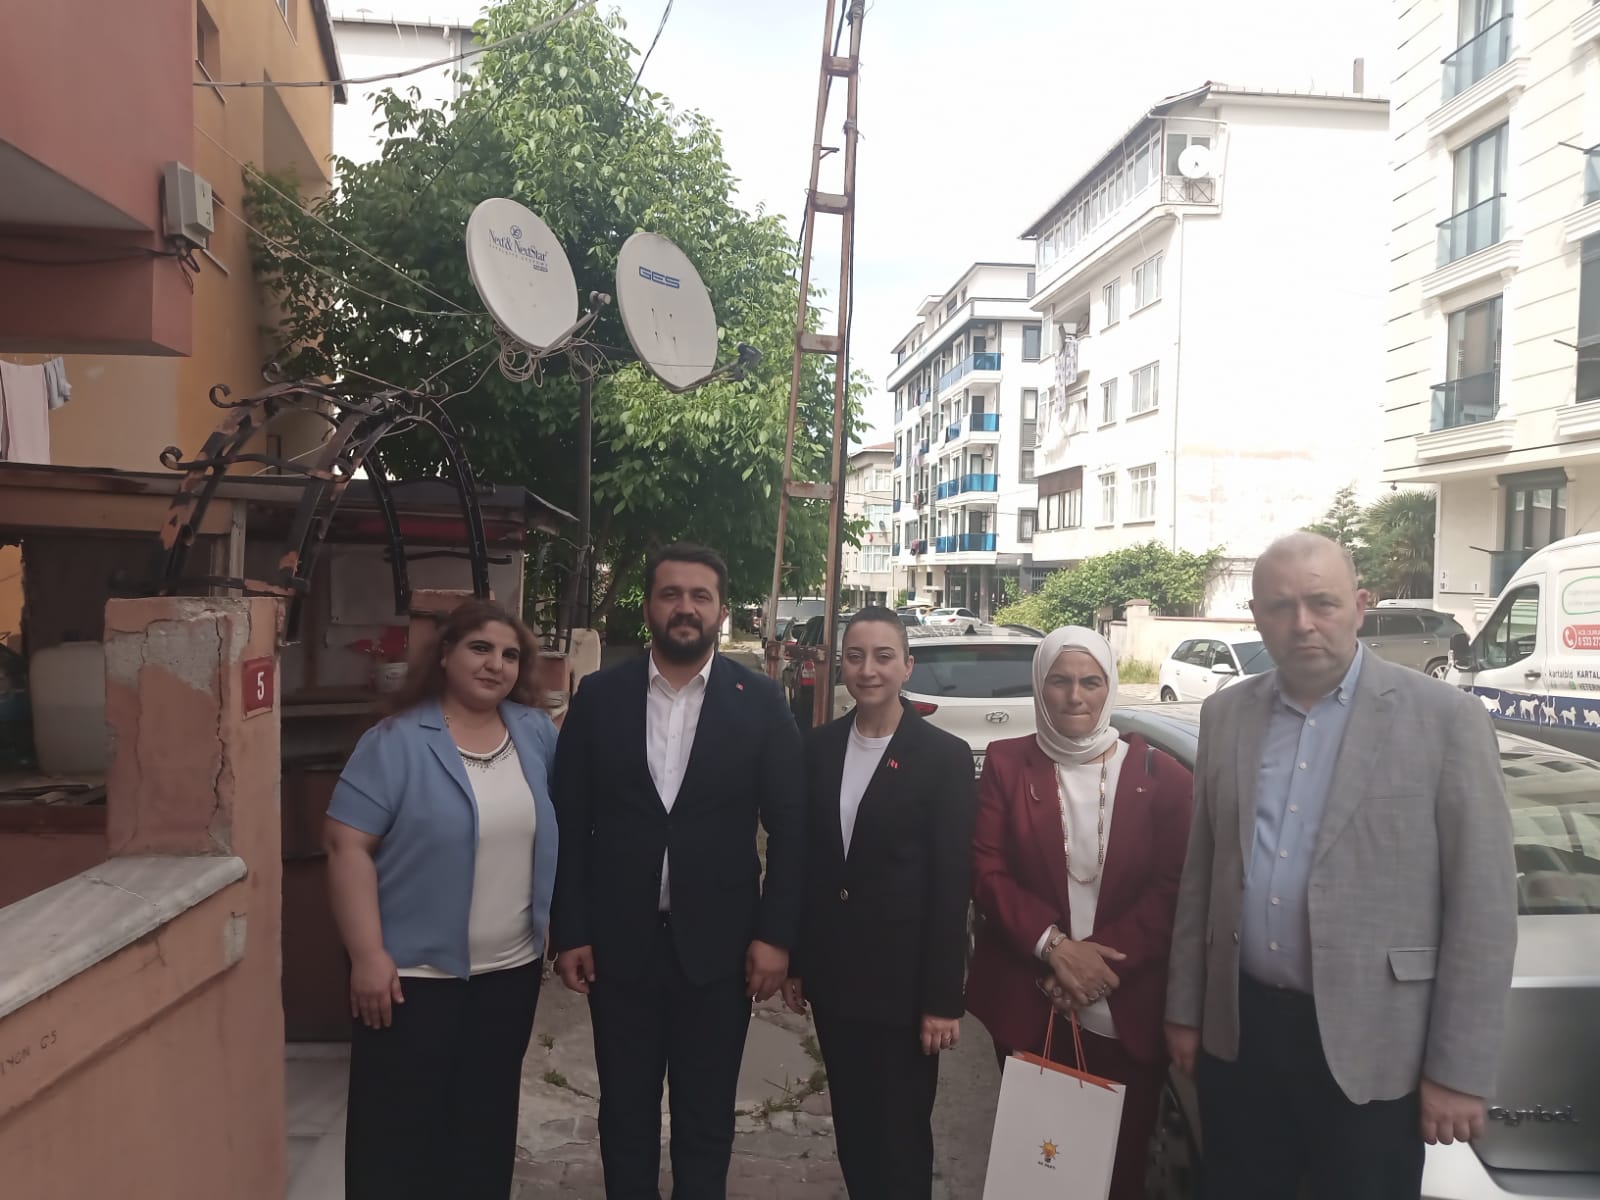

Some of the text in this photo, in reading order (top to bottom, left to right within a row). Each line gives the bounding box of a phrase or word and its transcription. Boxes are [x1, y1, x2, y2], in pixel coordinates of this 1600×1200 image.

[489, 228, 546, 262] Next & NextStar
[639, 266, 680, 289] GES
[256, 671, 265, 701] 5
